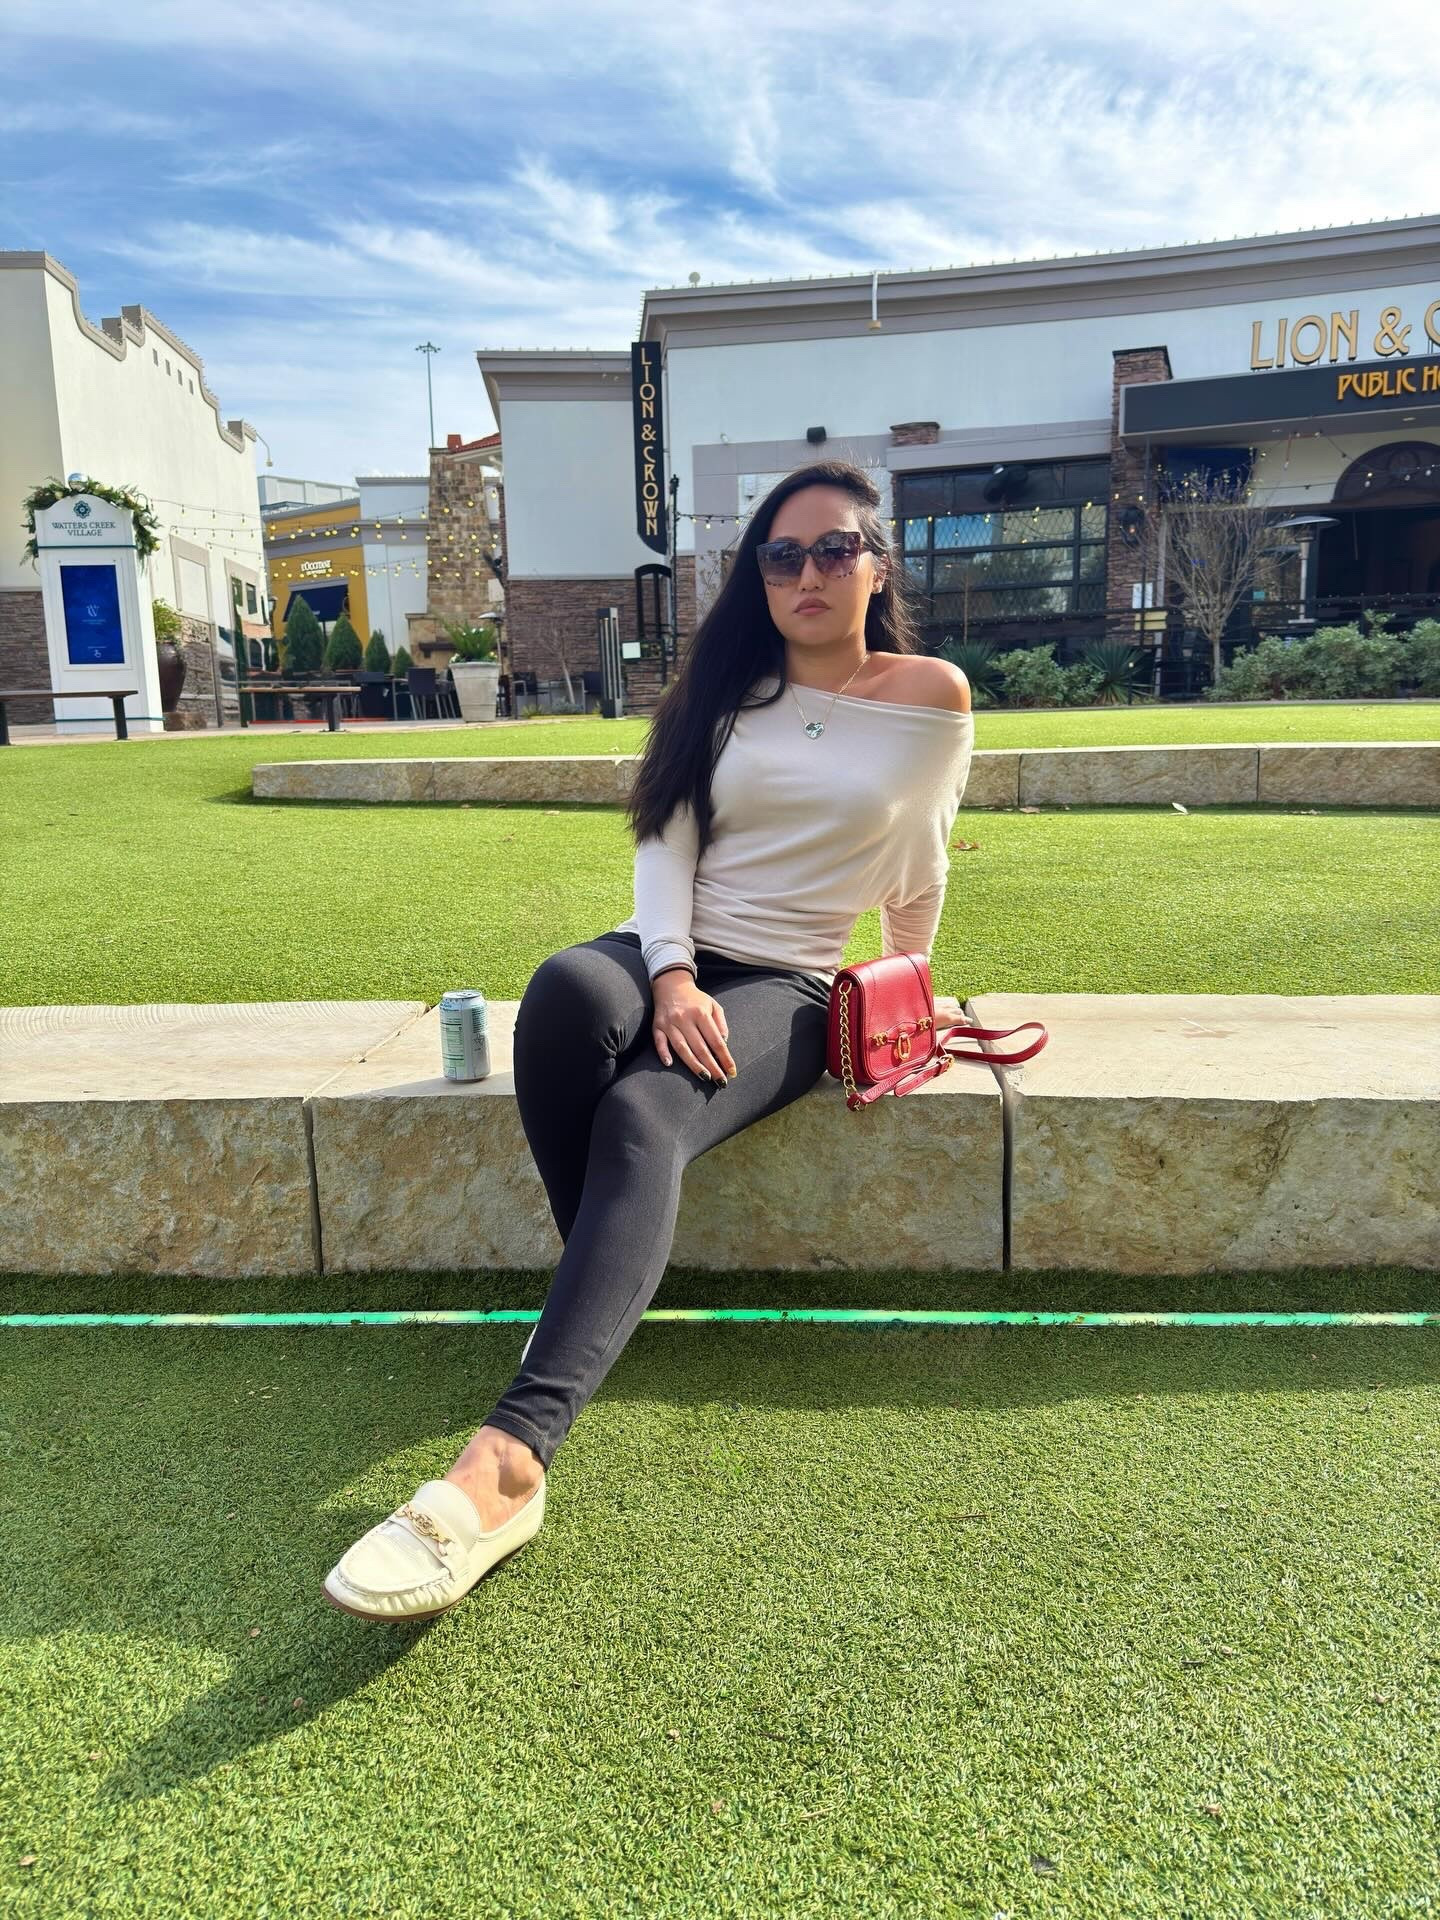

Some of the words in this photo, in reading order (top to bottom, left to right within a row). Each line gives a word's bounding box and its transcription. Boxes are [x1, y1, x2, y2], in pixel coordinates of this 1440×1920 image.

[1250, 309, 1360, 370] LION
[1374, 306, 1412, 356] &
[639, 347, 656, 419] LION
[1337, 367, 1417, 400] PUBLIC
[640, 424, 656, 441] &
[642, 445, 659, 536] CROWN
[89, 521, 116, 529] CREEK
